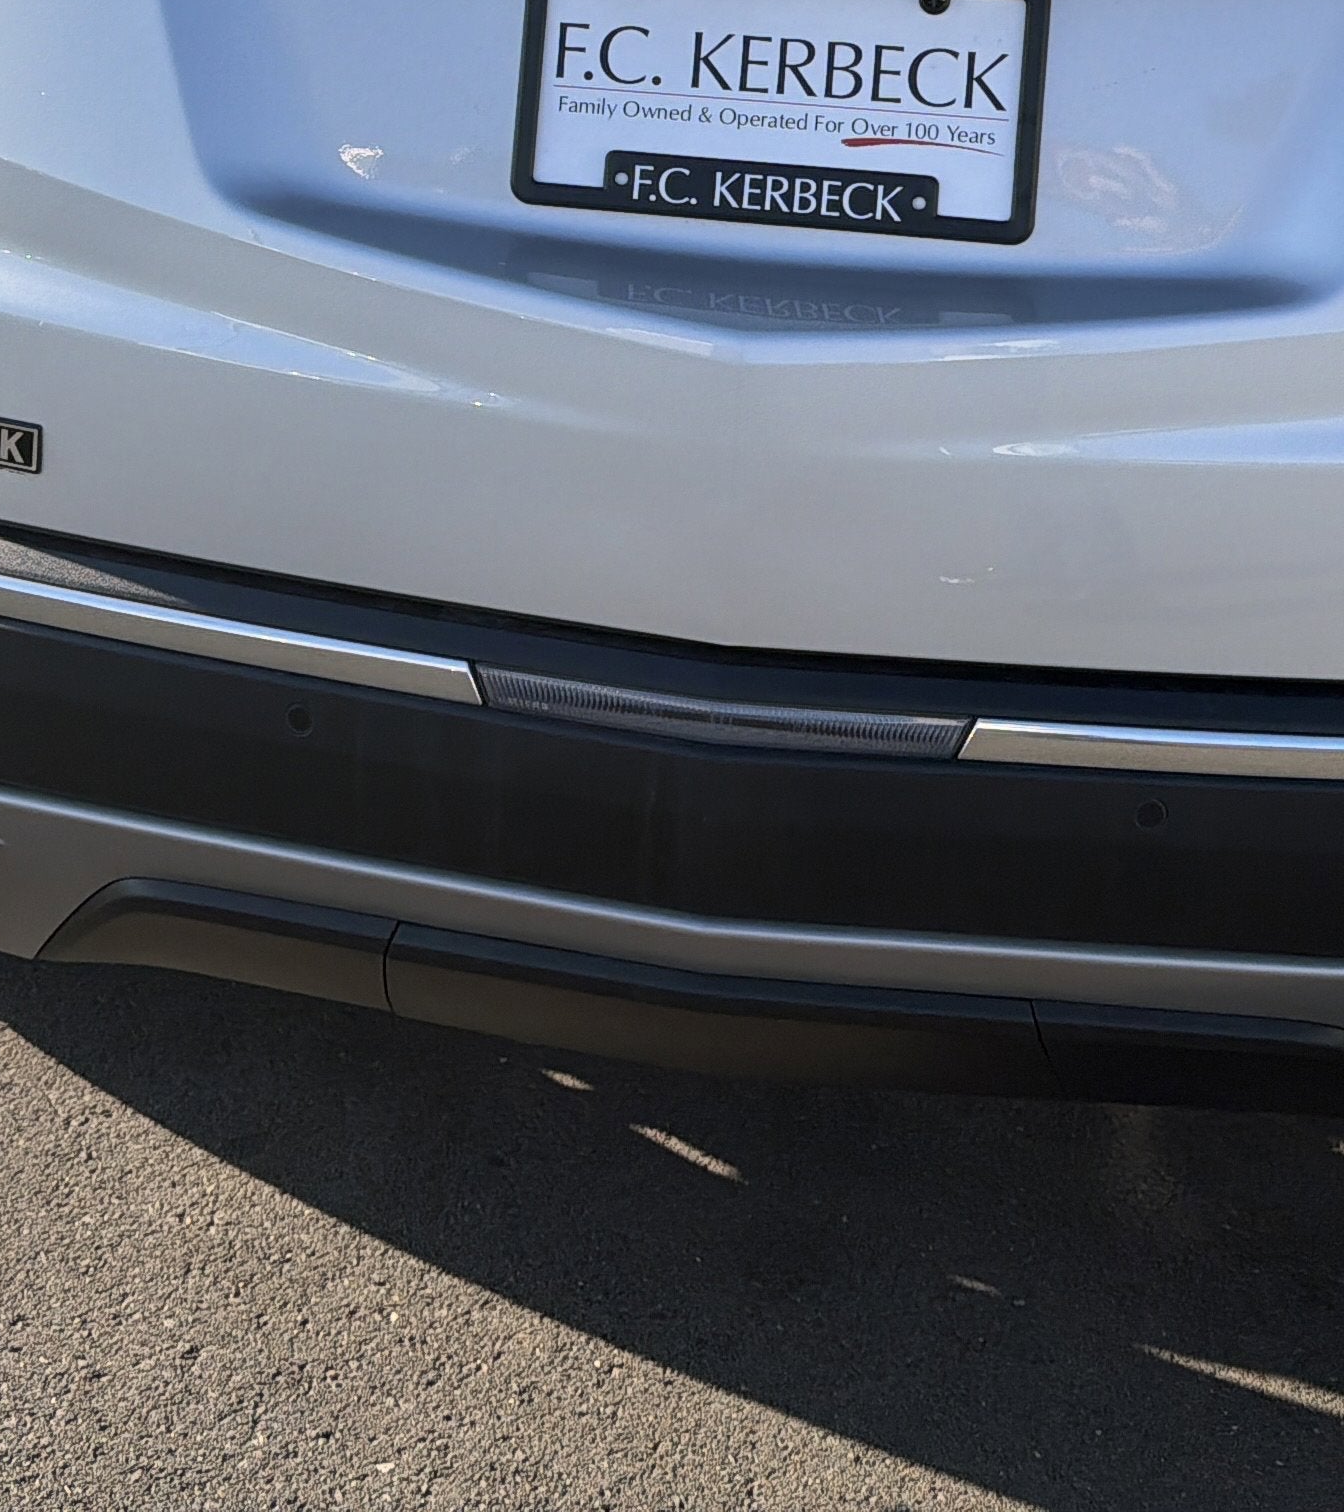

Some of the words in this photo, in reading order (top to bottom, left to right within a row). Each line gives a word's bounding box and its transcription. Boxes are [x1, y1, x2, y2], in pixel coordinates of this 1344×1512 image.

[555, 22, 662, 86] F.C.
[690, 31, 1009, 111] KERBECK
[558, 96, 618, 120] Family
[623, 101, 692, 122] Owned
[698, 107, 712, 123] &
[720, 108, 809, 129] Operated
[815, 115, 844, 133] For
[851, 118, 898, 137] Over
[906, 122, 939, 140] 100
[947, 125, 996, 145] Years
[632, 165, 698, 204] F.C.
[713, 172, 903, 222] KERBECK
